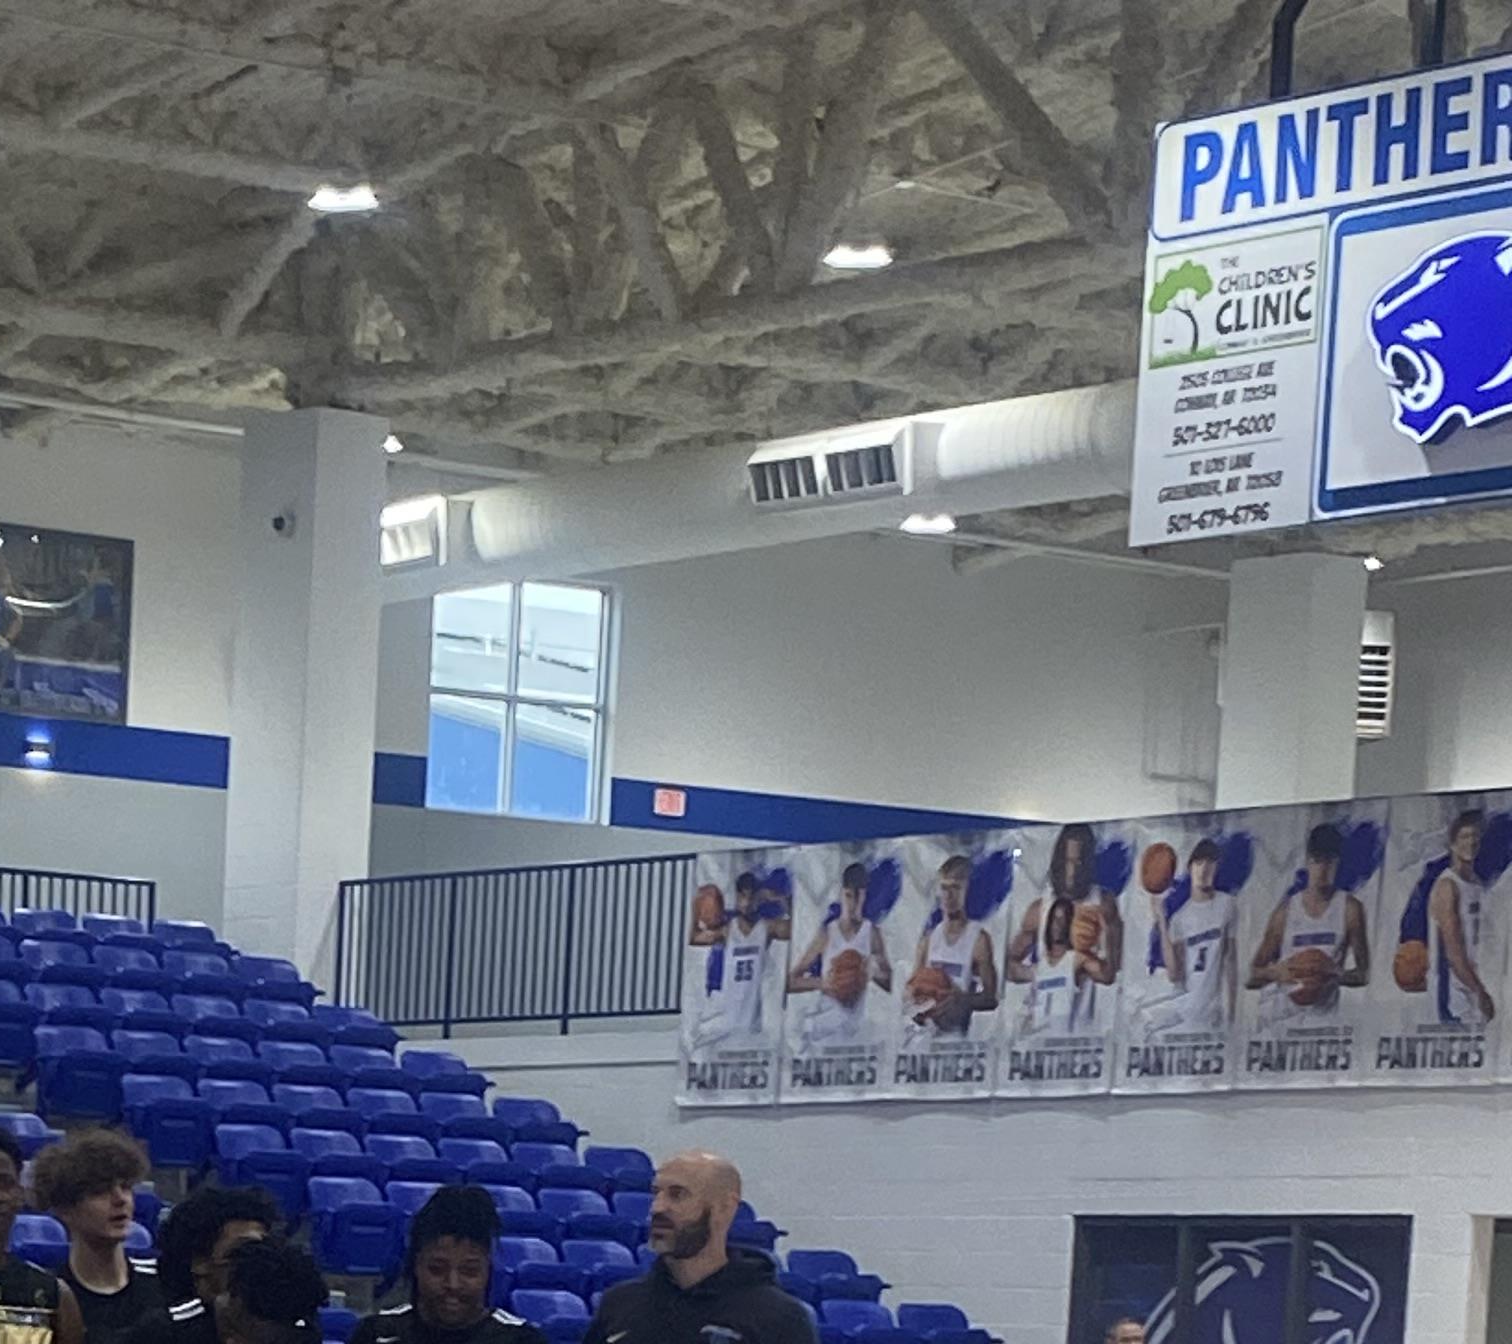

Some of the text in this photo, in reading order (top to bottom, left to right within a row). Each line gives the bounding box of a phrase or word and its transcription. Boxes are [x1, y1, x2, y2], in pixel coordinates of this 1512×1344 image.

[1217, 260, 1317, 296] CHILDREN'S
[1215, 285, 1313, 336] CLINIC
[894, 1051, 985, 1083] PANTHERS
[1008, 1047, 1103, 1081] PANTHERS
[1126, 1042, 1225, 1078] PANTHERS
[1246, 1038, 1353, 1072] PANTHERS
[1375, 1035, 1486, 1069] PANTHERS
[686, 1059, 770, 1090] PANTHERS
[791, 1055, 878, 1088] PANTHERS
